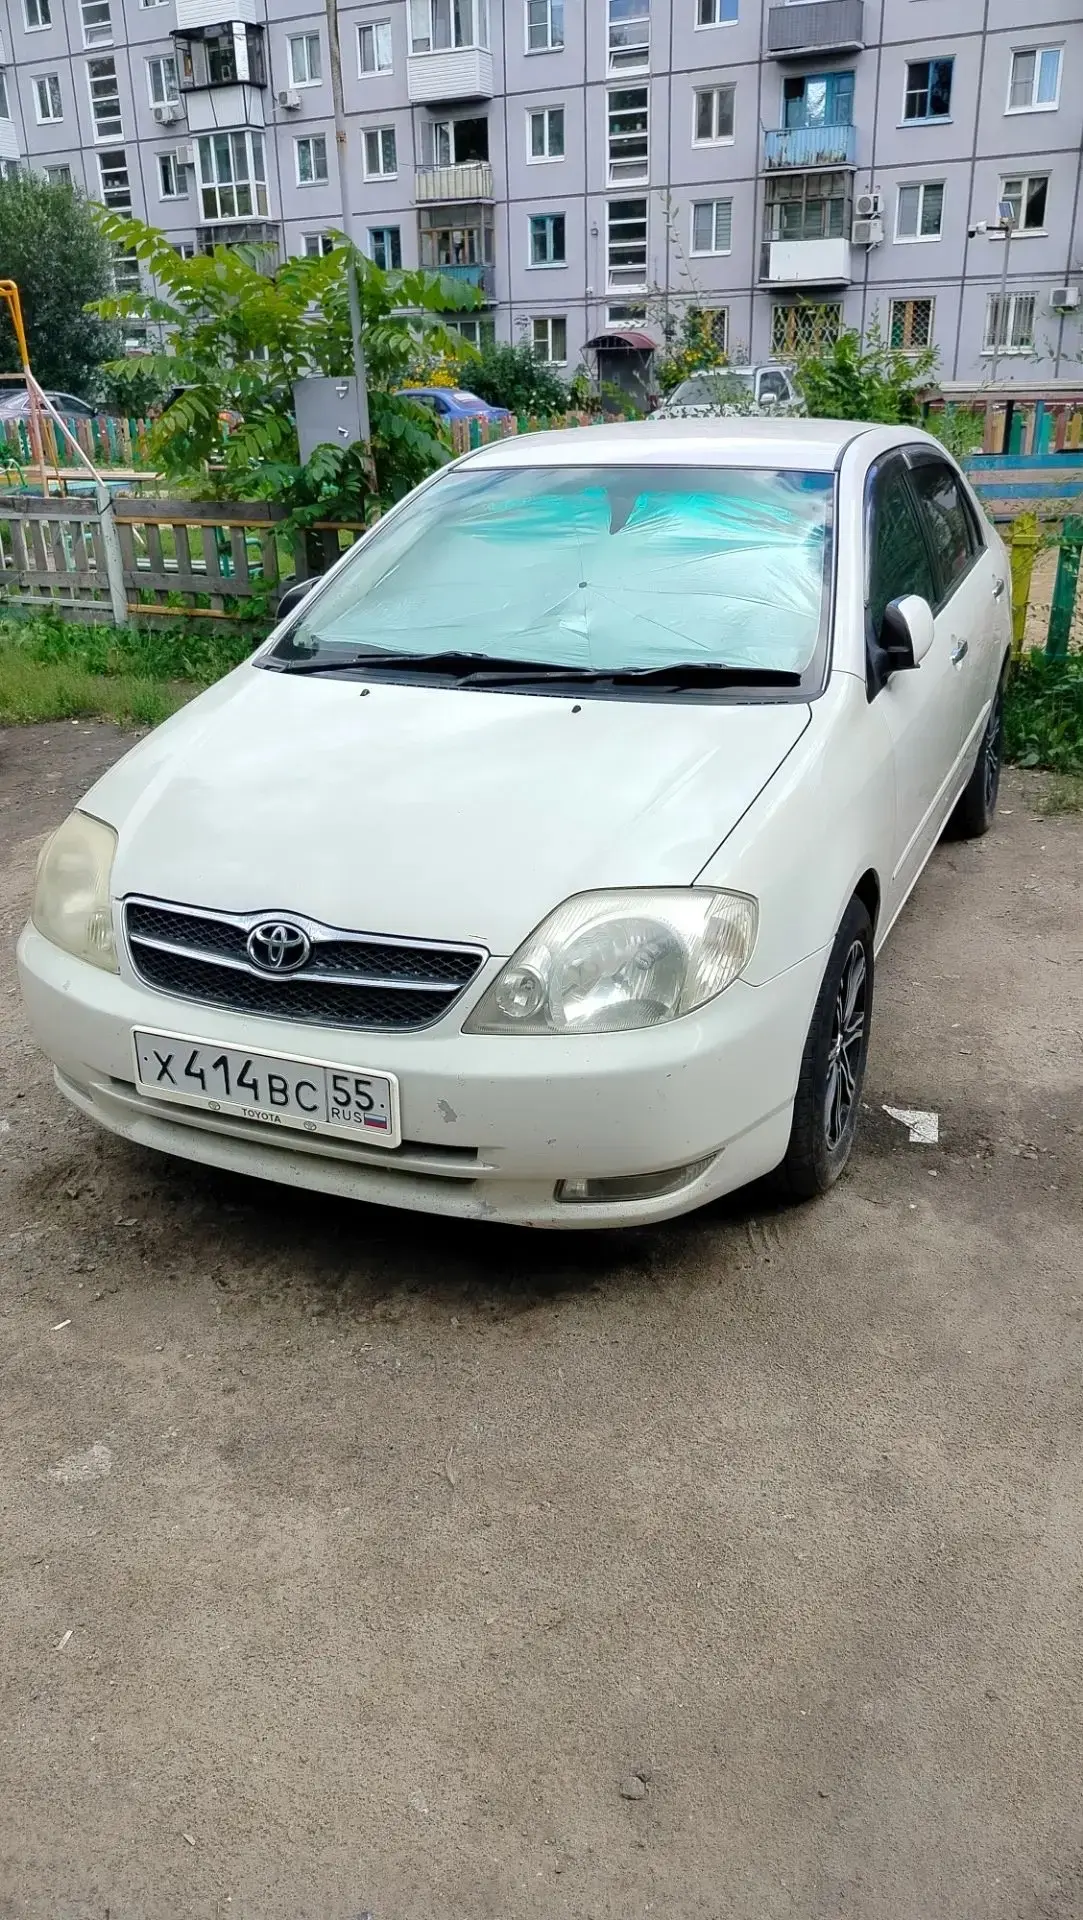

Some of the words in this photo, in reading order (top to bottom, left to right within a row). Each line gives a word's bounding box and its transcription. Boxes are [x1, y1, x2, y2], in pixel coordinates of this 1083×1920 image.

[332, 1074, 374, 1112] 55
[241, 1108, 282, 1124] TOYOTA
[331, 1107, 362, 1124] RUS
